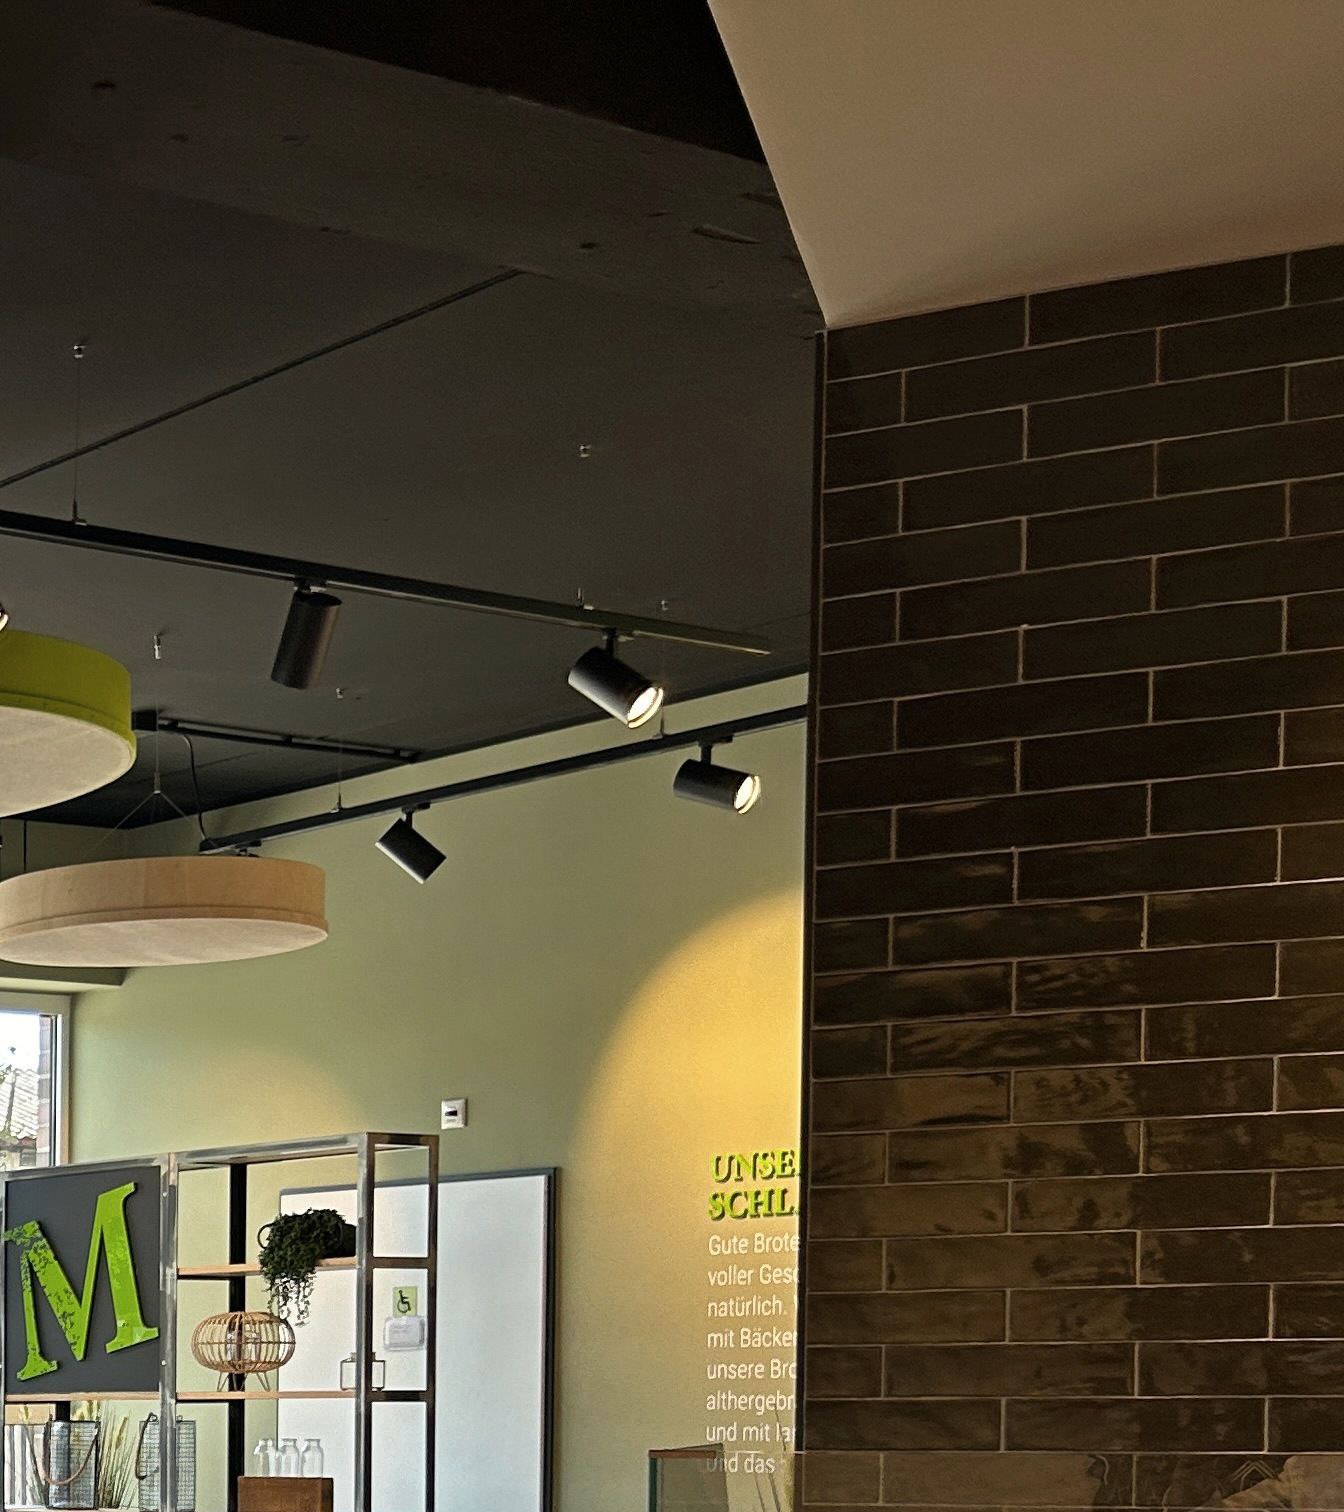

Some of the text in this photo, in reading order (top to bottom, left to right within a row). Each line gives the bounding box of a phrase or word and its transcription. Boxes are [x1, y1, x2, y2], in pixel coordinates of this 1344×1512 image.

[711, 1150, 799, 1183] UNSE
[708, 1187, 799, 1221] SCHL
[708, 1234, 749, 1256] Gute
[2, 1182, 160, 1381] M
[708, 1264, 754, 1287] voller
[707, 1294, 788, 1317] natürlich.
[707, 1328, 735, 1348] mit
[707, 1363, 765, 1379] unsere
[706, 1422, 737, 1441] und
[742, 1422, 771, 1442] mit
[707, 1451, 739, 1473] und
[744, 1453, 776, 1473] das
